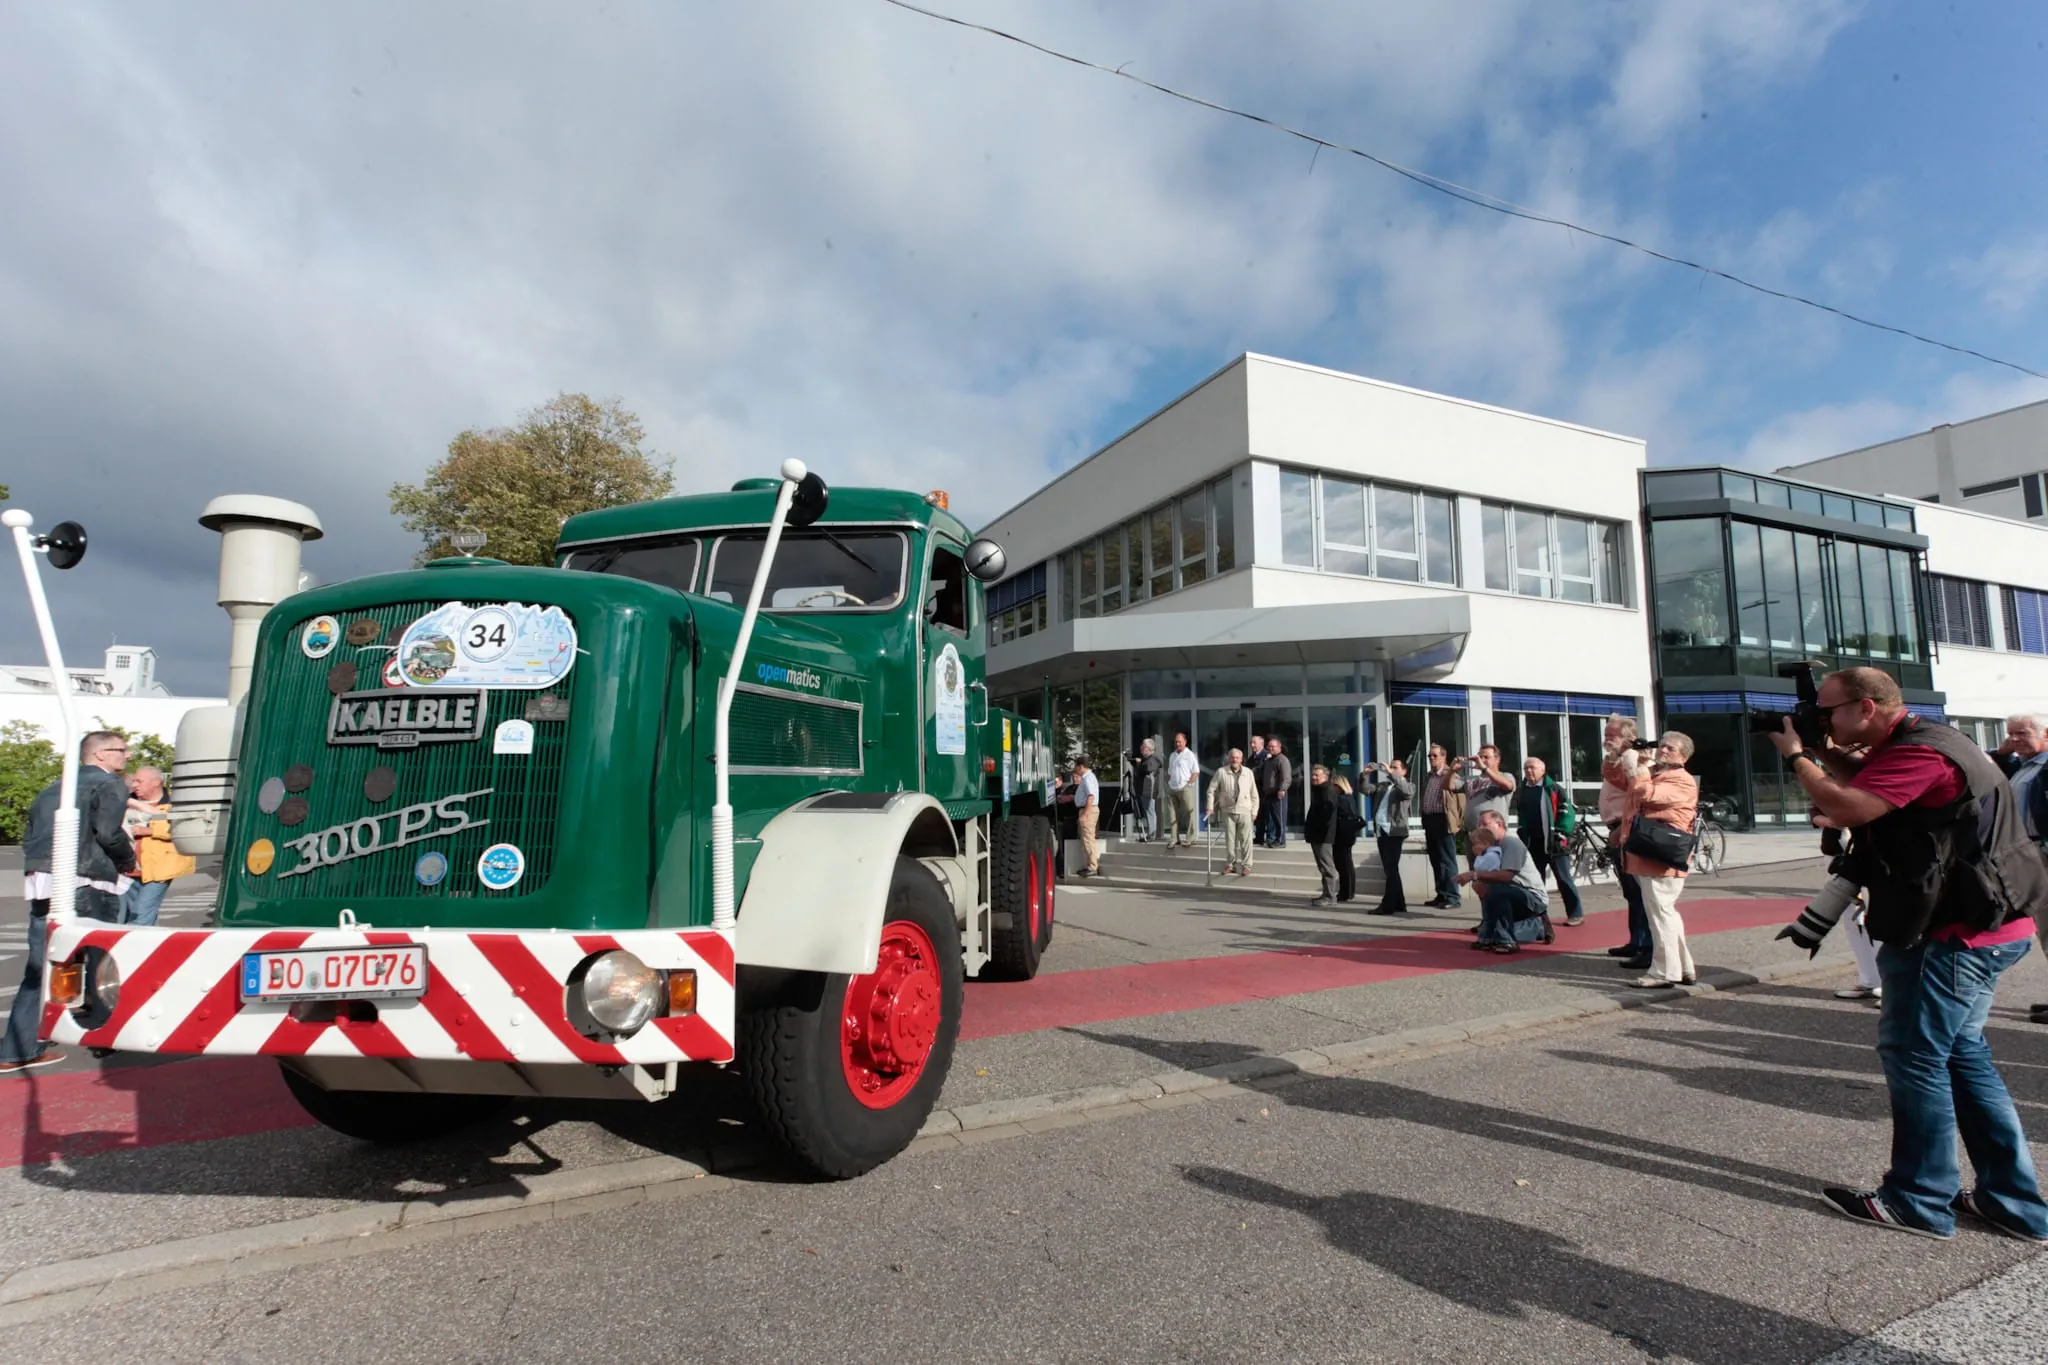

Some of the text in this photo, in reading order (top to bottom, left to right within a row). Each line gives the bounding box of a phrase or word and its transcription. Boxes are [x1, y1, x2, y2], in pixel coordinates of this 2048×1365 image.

[468, 623, 507, 649] 34
[757, 662, 821, 690] openmatics
[337, 698, 475, 733] KAELBLE
[294, 794, 470, 874] 300 PS
